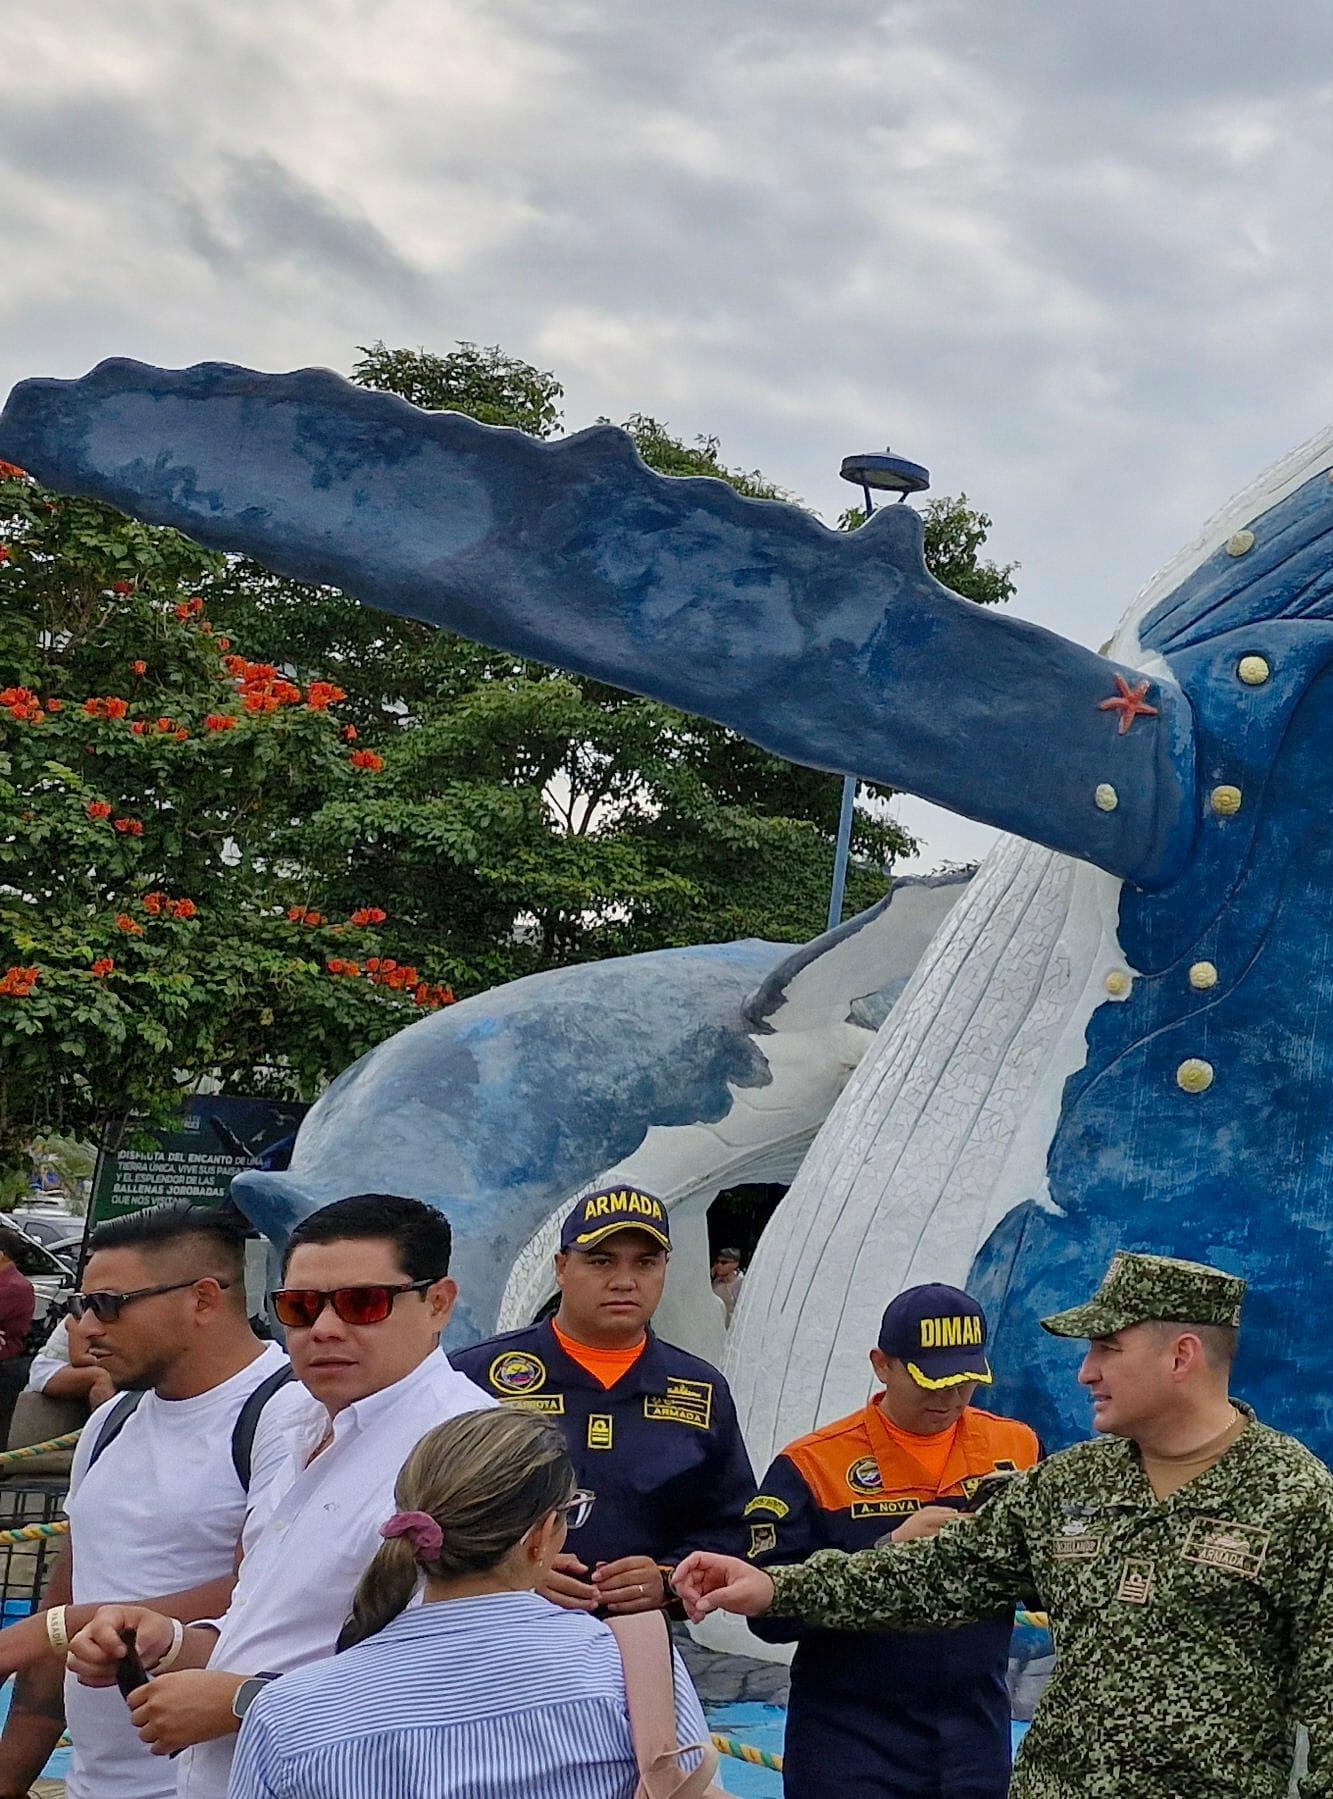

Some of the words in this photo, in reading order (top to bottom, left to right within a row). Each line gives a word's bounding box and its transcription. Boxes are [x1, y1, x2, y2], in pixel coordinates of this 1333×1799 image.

[168, 1152, 186, 1163] DEL
[188, 1153, 233, 1165] ENCANTO
[118, 1161, 148, 1171] TIERRA
[178, 1164, 198, 1175] VIVE
[198, 1165, 215, 1175] SUS
[116, 1172, 122, 1182] Y
[123, 1173, 134, 1183] EL
[134, 1173, 185, 1185] ESPLENDOR
[185, 1175, 197, 1185] DE
[197, 1175, 216, 1186] LAS
[113, 1183, 164, 1195] BALLENAS
[166, 1185, 225, 1197] JOROBADAS
[111, 1194, 131, 1204] QUE
[131, 1195, 150, 1206] NOS
[584, 1190, 663, 1222] ARMADA
[920, 1315, 983, 1348] DIMAR
[652, 1407, 702, 1423] ARMADA
[861, 1503, 873, 1513] A.
[880, 1501, 915, 1513] NOVA
[1198, 1548, 1245, 1567] ARMADA
